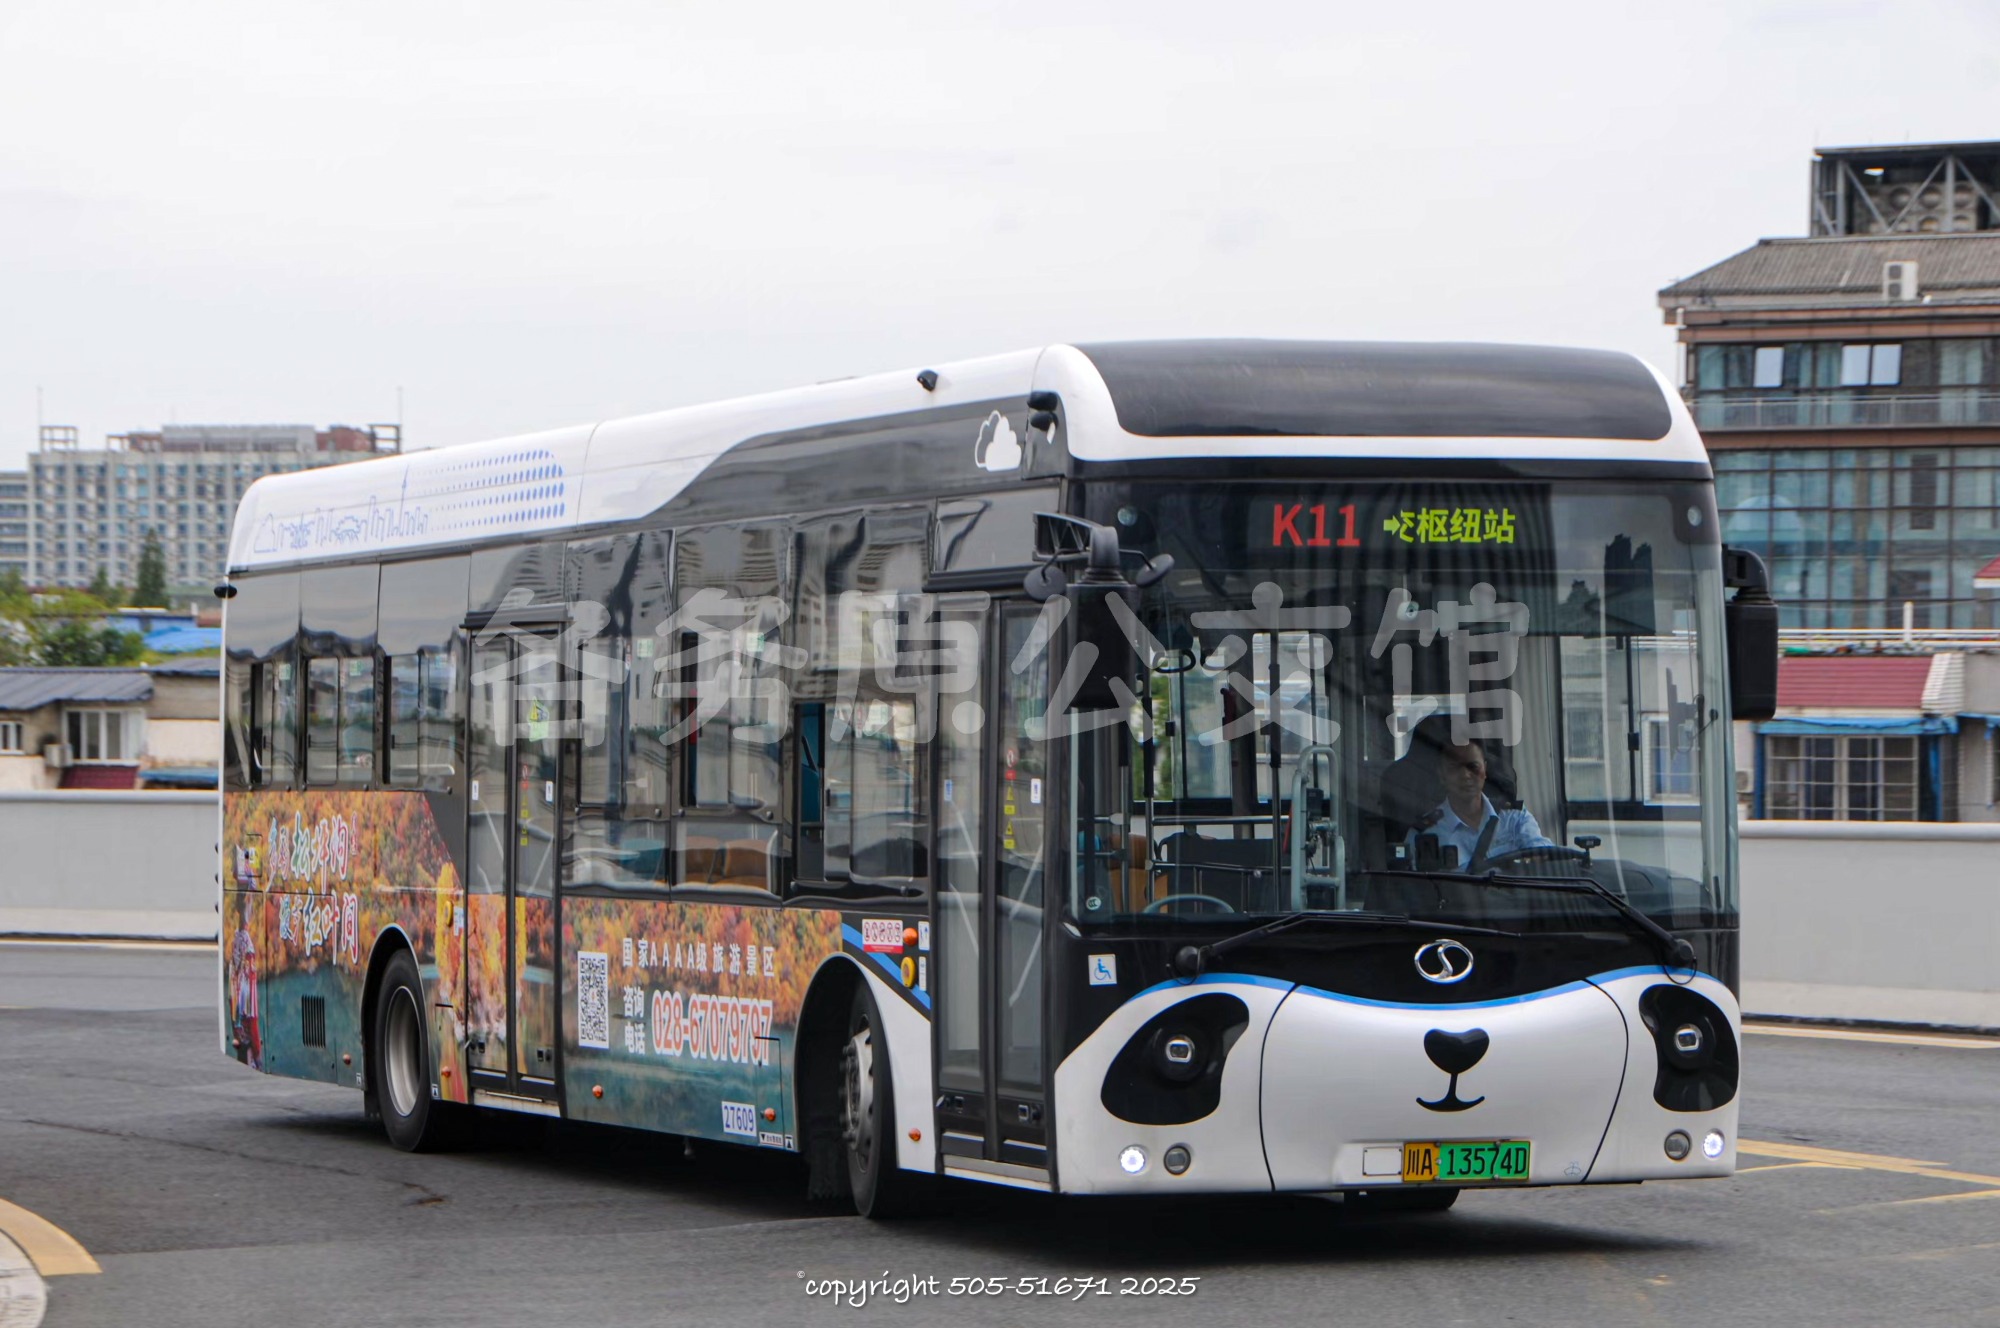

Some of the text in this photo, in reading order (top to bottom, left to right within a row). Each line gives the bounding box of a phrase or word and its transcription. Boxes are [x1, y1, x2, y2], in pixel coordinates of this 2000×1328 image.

[1272, 502, 1360, 547] K11
[623, 985, 645, 1019] 咨询
[624, 1022, 646, 1055] 电话
[652, 989, 773, 1066] 028-67079797
[723, 1105, 754, 1132] 27609
